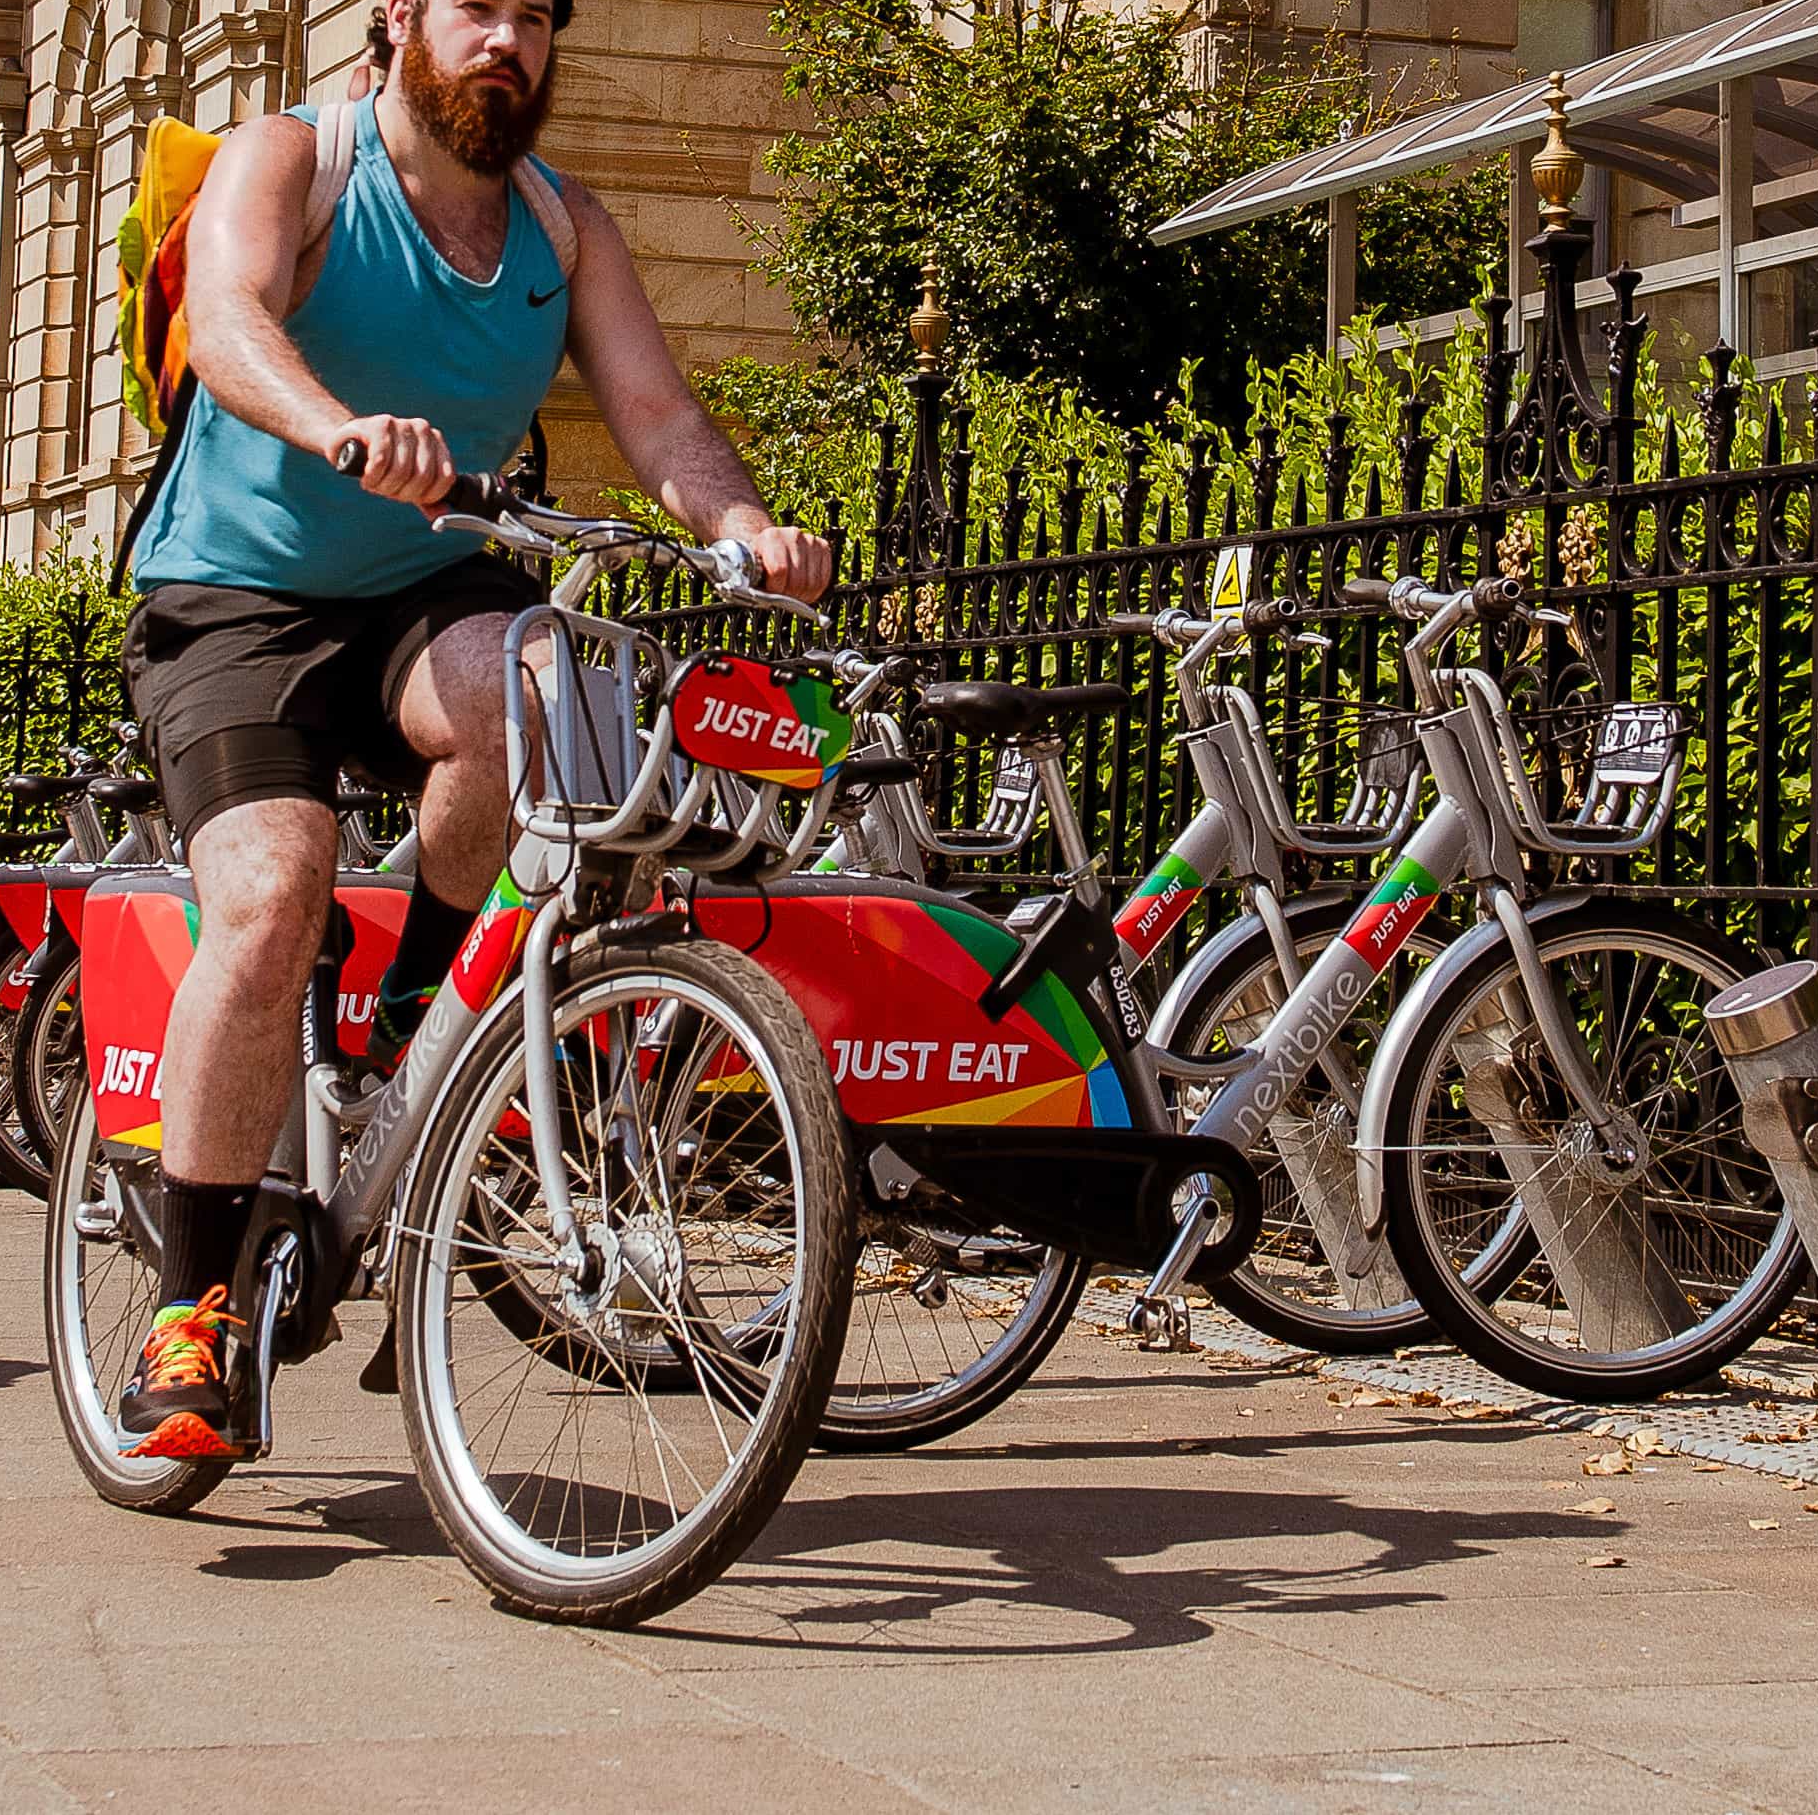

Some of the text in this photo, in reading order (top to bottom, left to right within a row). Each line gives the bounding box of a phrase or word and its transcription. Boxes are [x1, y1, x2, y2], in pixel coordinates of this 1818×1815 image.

[694, 696, 830, 758] JUST EAT
[1136, 875, 1183, 937] JUST EAT
[1370, 884, 1420, 949] JUST EAT
[461, 929, 485, 974] JUST
[1110, 964, 1142, 1039] 830283
[97, 1045, 156, 1097] JUST
[833, 1040, 1029, 1085] JUST EAT
[1233, 970, 1362, 1137] nextbike
